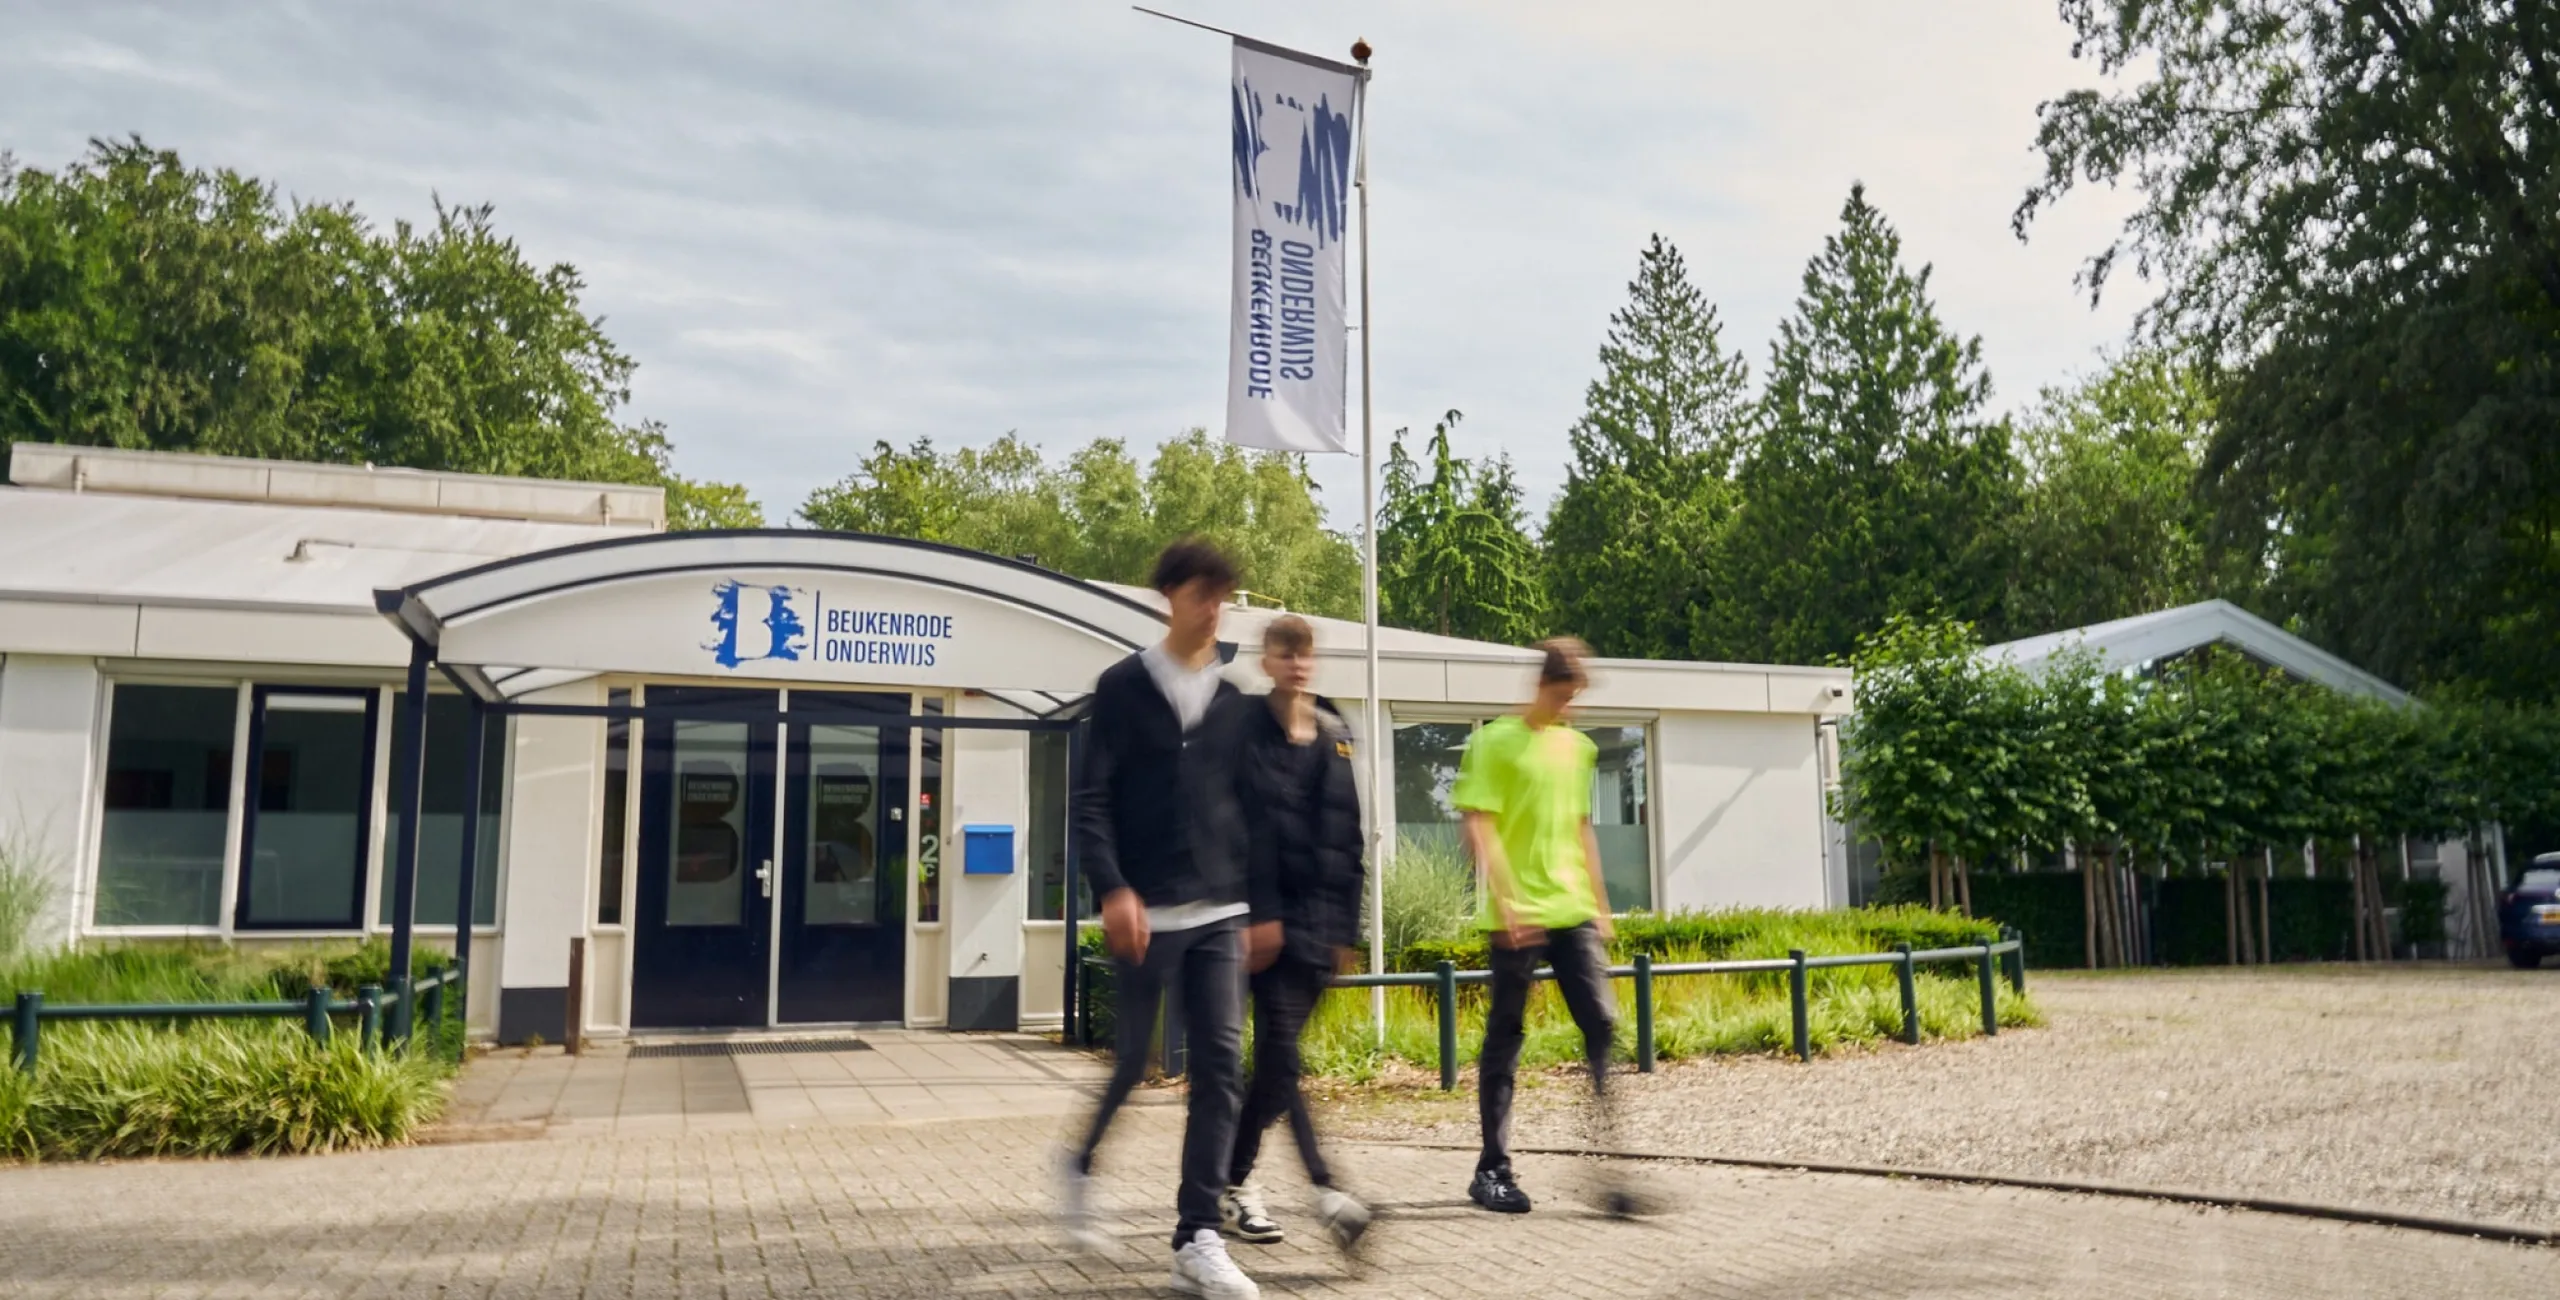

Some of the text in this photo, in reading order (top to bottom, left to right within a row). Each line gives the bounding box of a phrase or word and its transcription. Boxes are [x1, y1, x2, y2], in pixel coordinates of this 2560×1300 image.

[827, 609, 953, 639] BEUKENRODE
[826, 639, 935, 667] ONDERWIJS
[920, 834, 939, 863] 2
